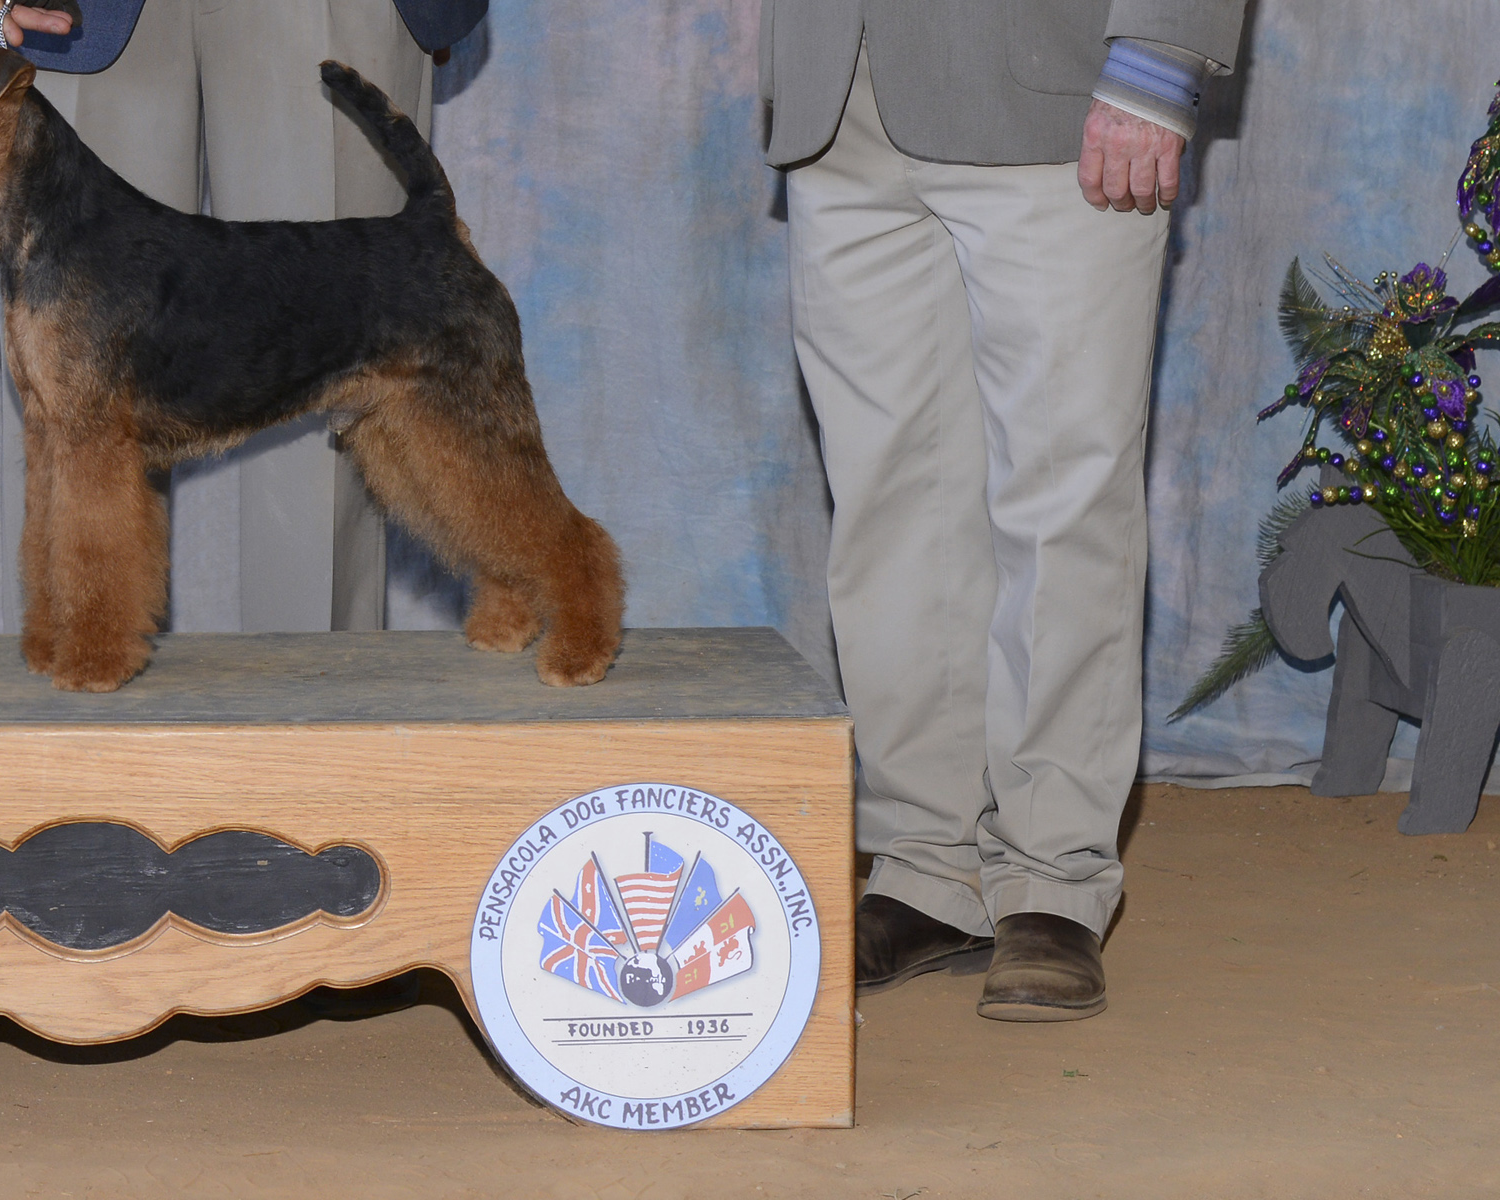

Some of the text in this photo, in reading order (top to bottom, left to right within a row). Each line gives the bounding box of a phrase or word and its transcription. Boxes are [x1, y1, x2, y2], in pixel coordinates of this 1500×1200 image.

[478, 825, 557, 941] PENSACOLA
[560, 795, 606, 829] DOG
[615, 787, 730, 829] FANCIERS
[784, 888, 813, 938] INC.
[567, 1018, 730, 1038] FOUNDED 1936
[561, 1083, 735, 1126] AKC MEMBER
